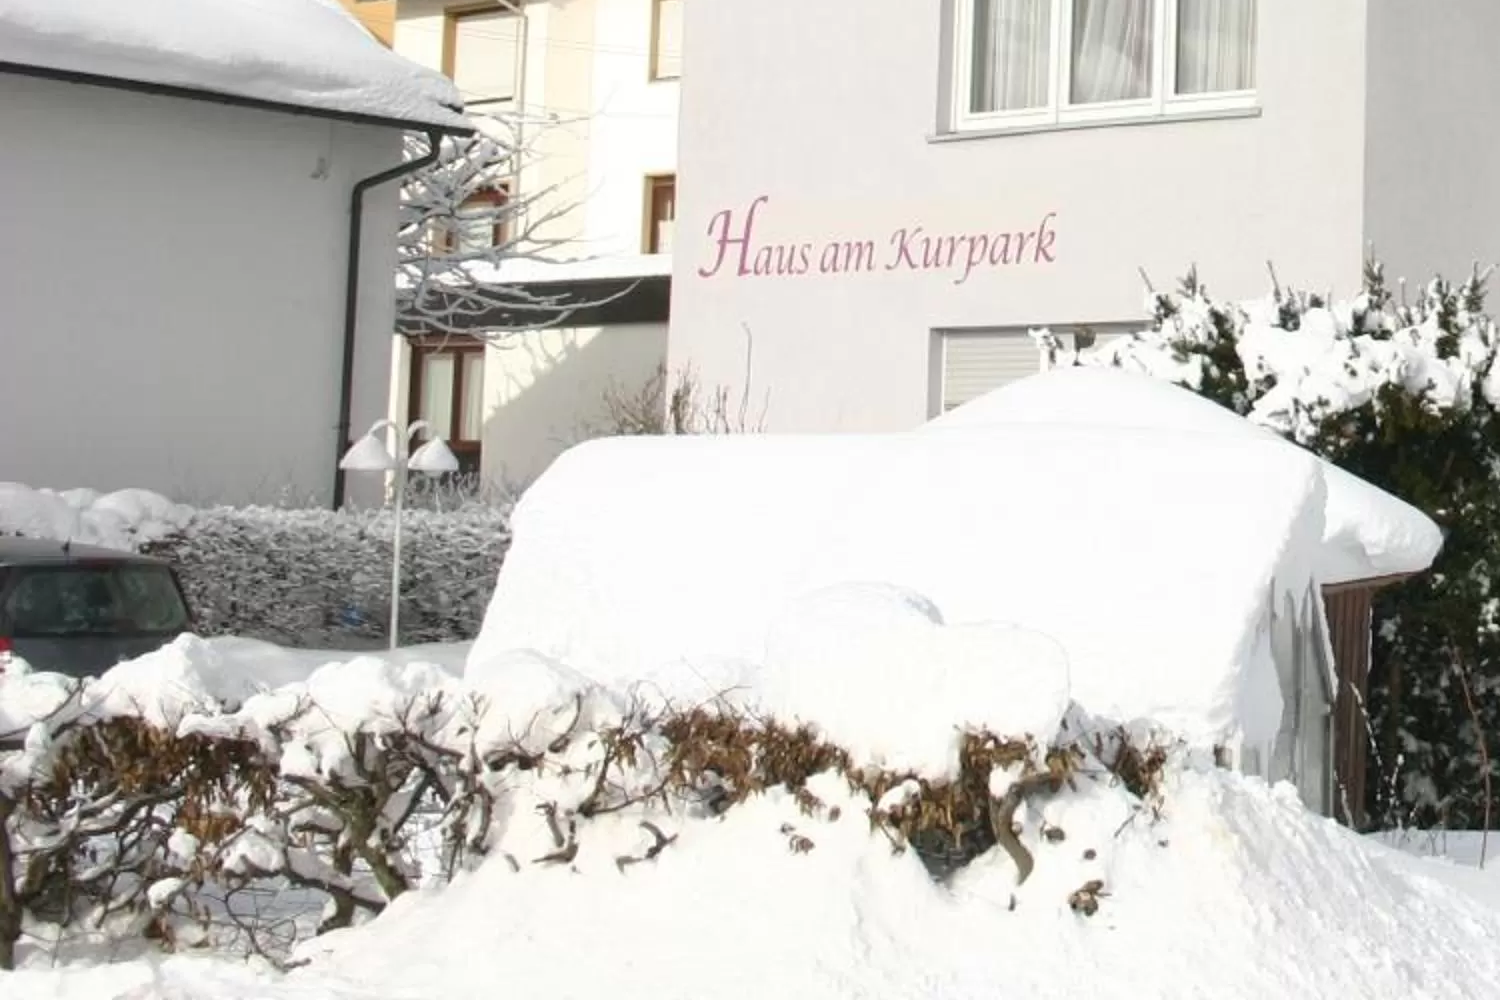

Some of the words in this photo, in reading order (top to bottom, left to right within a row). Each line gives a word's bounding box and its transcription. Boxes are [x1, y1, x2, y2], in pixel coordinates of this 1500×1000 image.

[698, 195, 811, 278] Haus
[819, 239, 876, 274] am
[885, 212, 1057, 285] Kurpark
